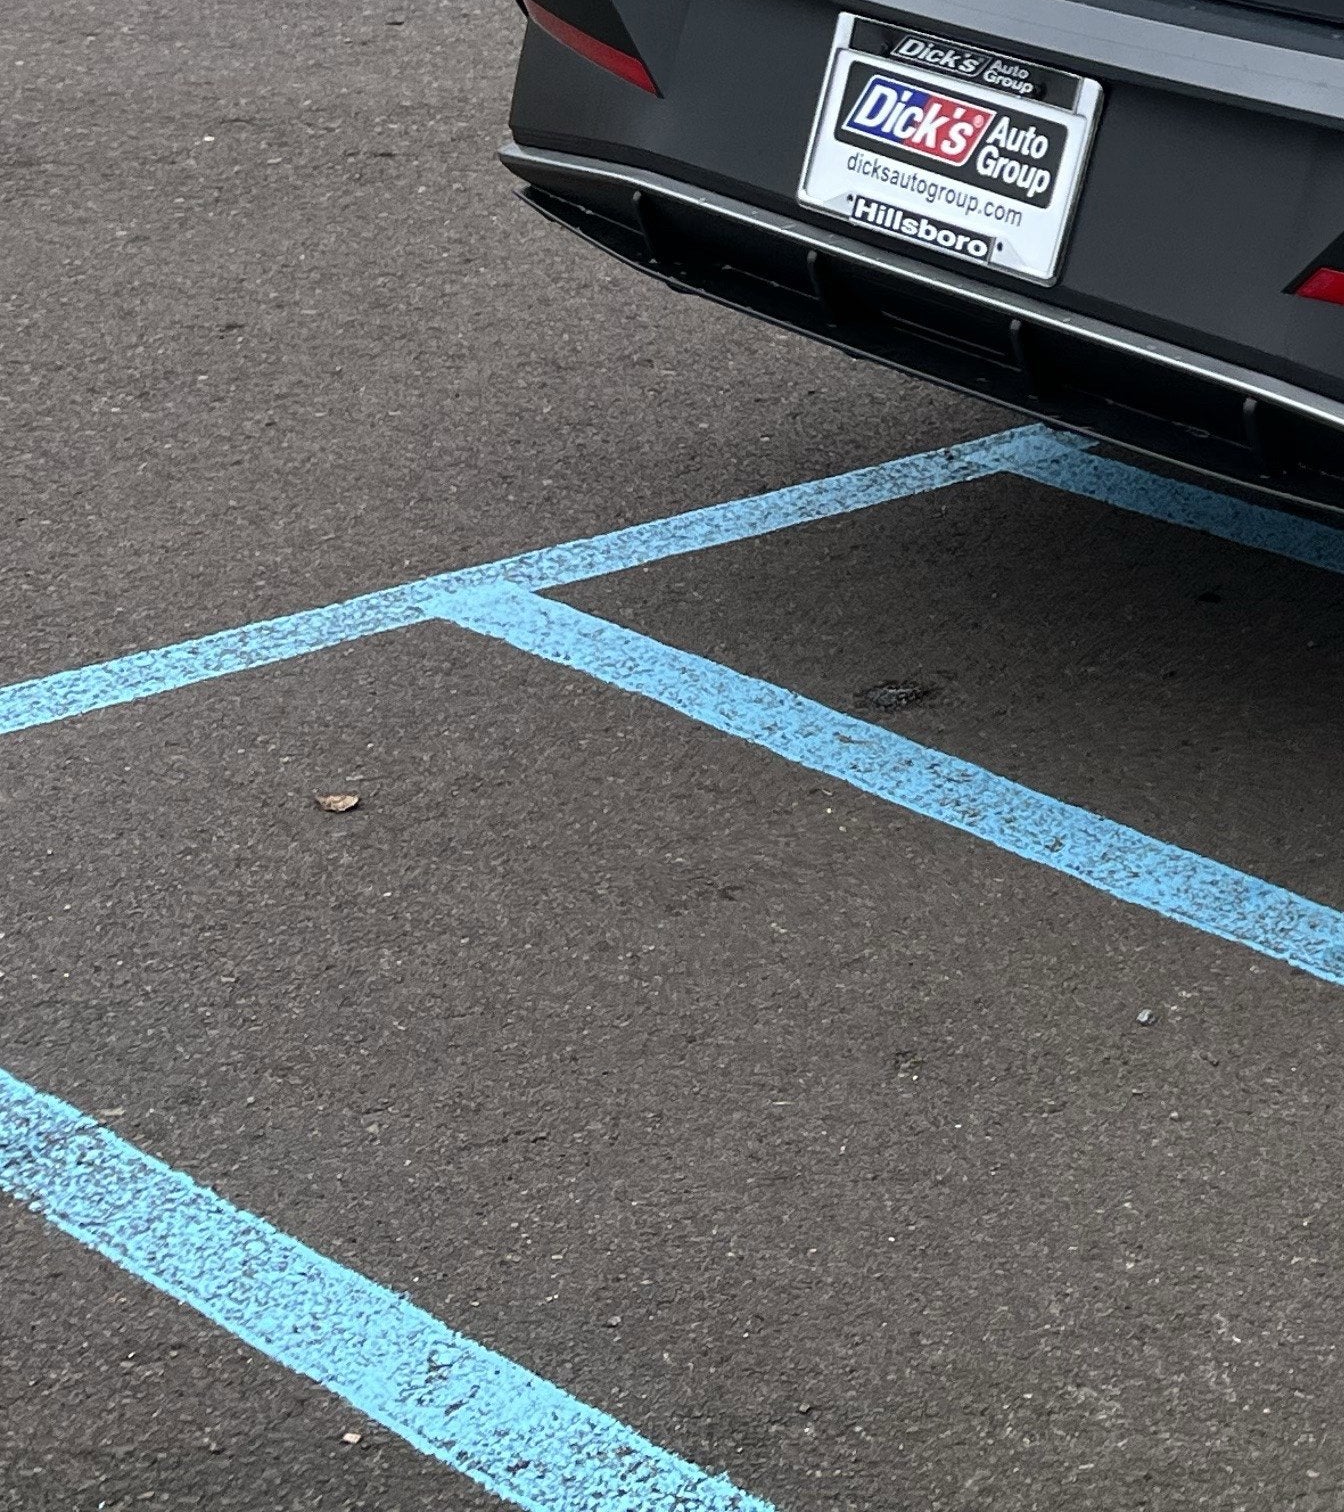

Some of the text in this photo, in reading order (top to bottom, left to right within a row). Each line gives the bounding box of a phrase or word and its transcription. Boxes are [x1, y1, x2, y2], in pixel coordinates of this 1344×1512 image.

[899, 39, 979, 73] Dick's
[989, 59, 1030, 80] Auto
[983, 70, 1034, 94] Group
[854, 84, 974, 155] Dick's
[986, 116, 1049, 159] Auto
[847, 152, 1023, 227] dicksautogroup.com
[975, 145, 1051, 198] Group
[853, 198, 989, 257] Hillsboro
